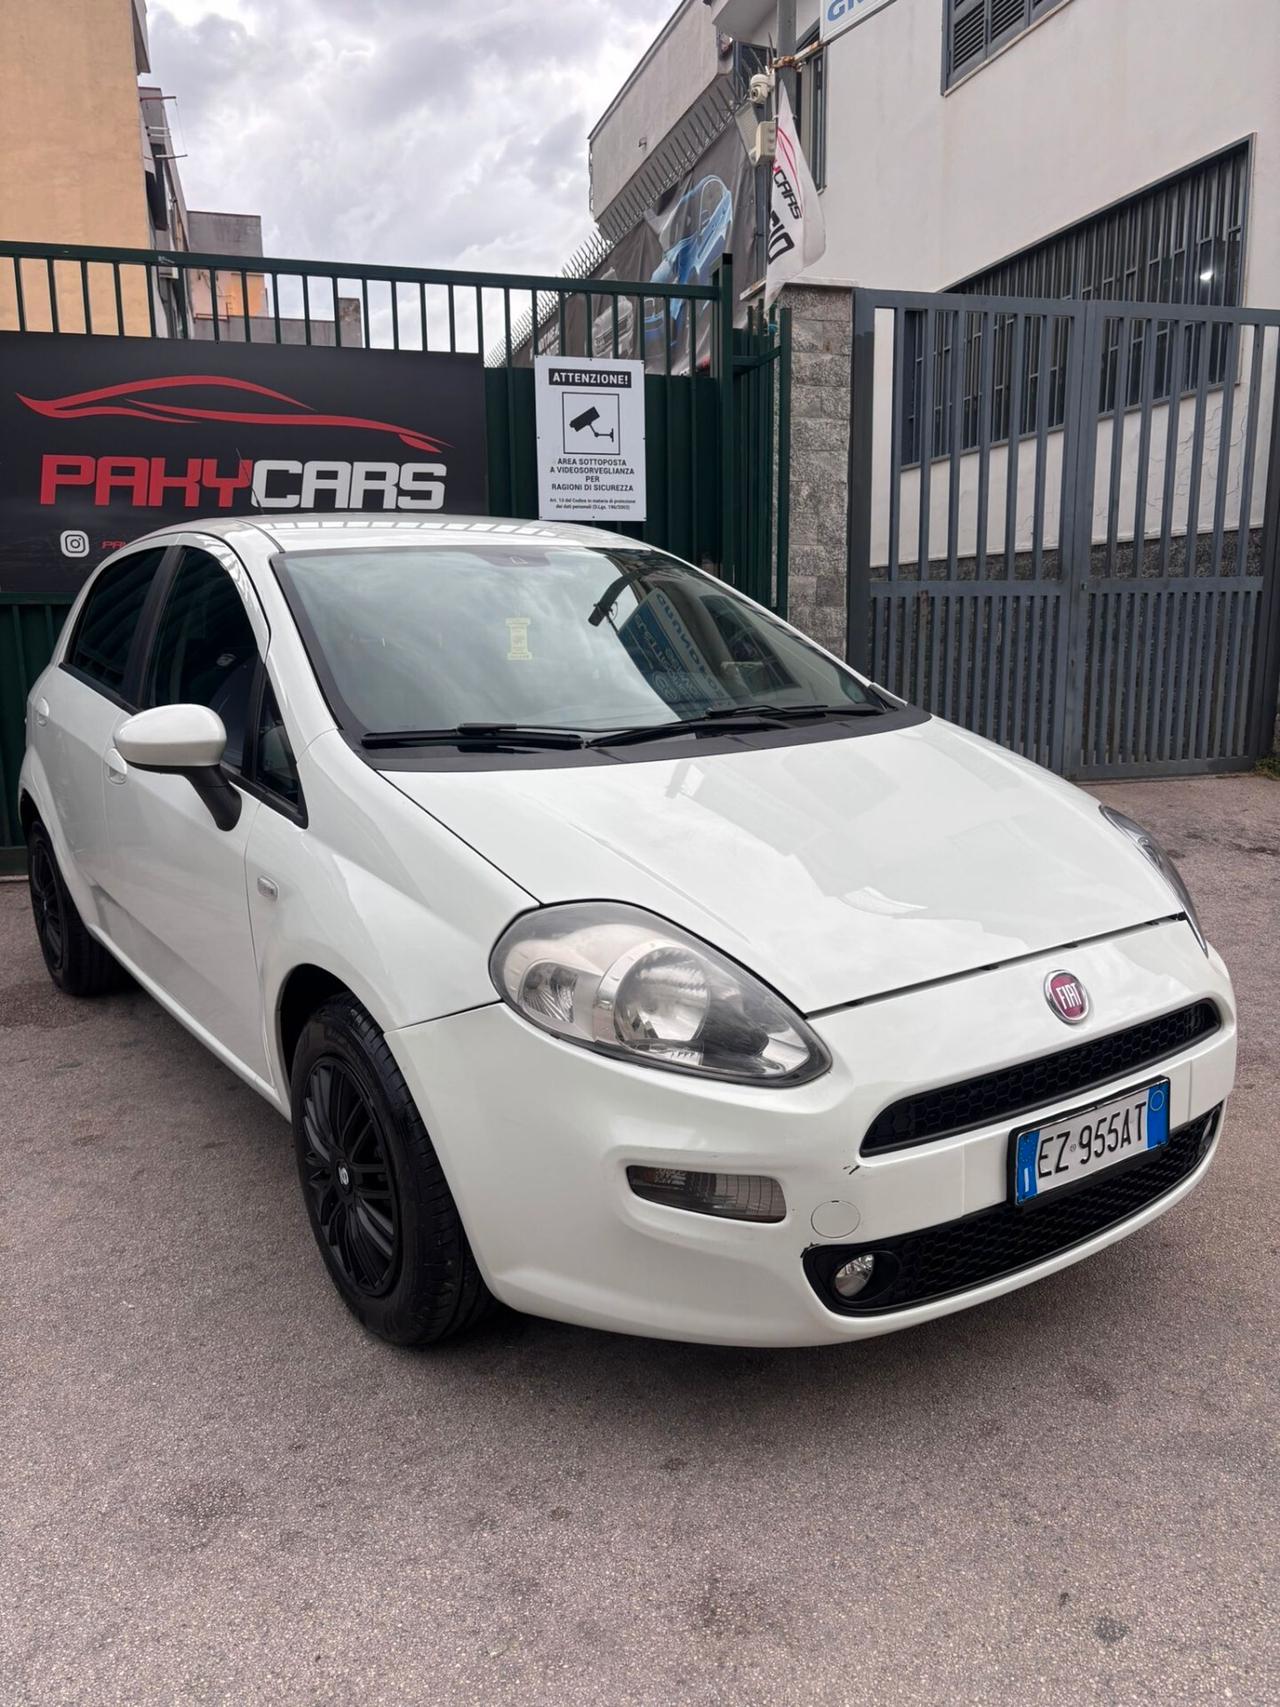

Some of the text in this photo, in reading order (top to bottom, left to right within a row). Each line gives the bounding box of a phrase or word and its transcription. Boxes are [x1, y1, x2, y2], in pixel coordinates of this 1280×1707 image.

[553, 372, 628, 385] ATTENZIONE!
[579, 458, 627, 466] SOTTOPOSTA
[557, 466, 634, 475] VIDEOSORVEGLIANZA
[40, 454, 447, 510] PAKYCARS
[551, 483, 582, 491] RAGIONI
[593, 484, 634, 492] SICUREZZA
[1056, 983, 1082, 1010] FIAT
